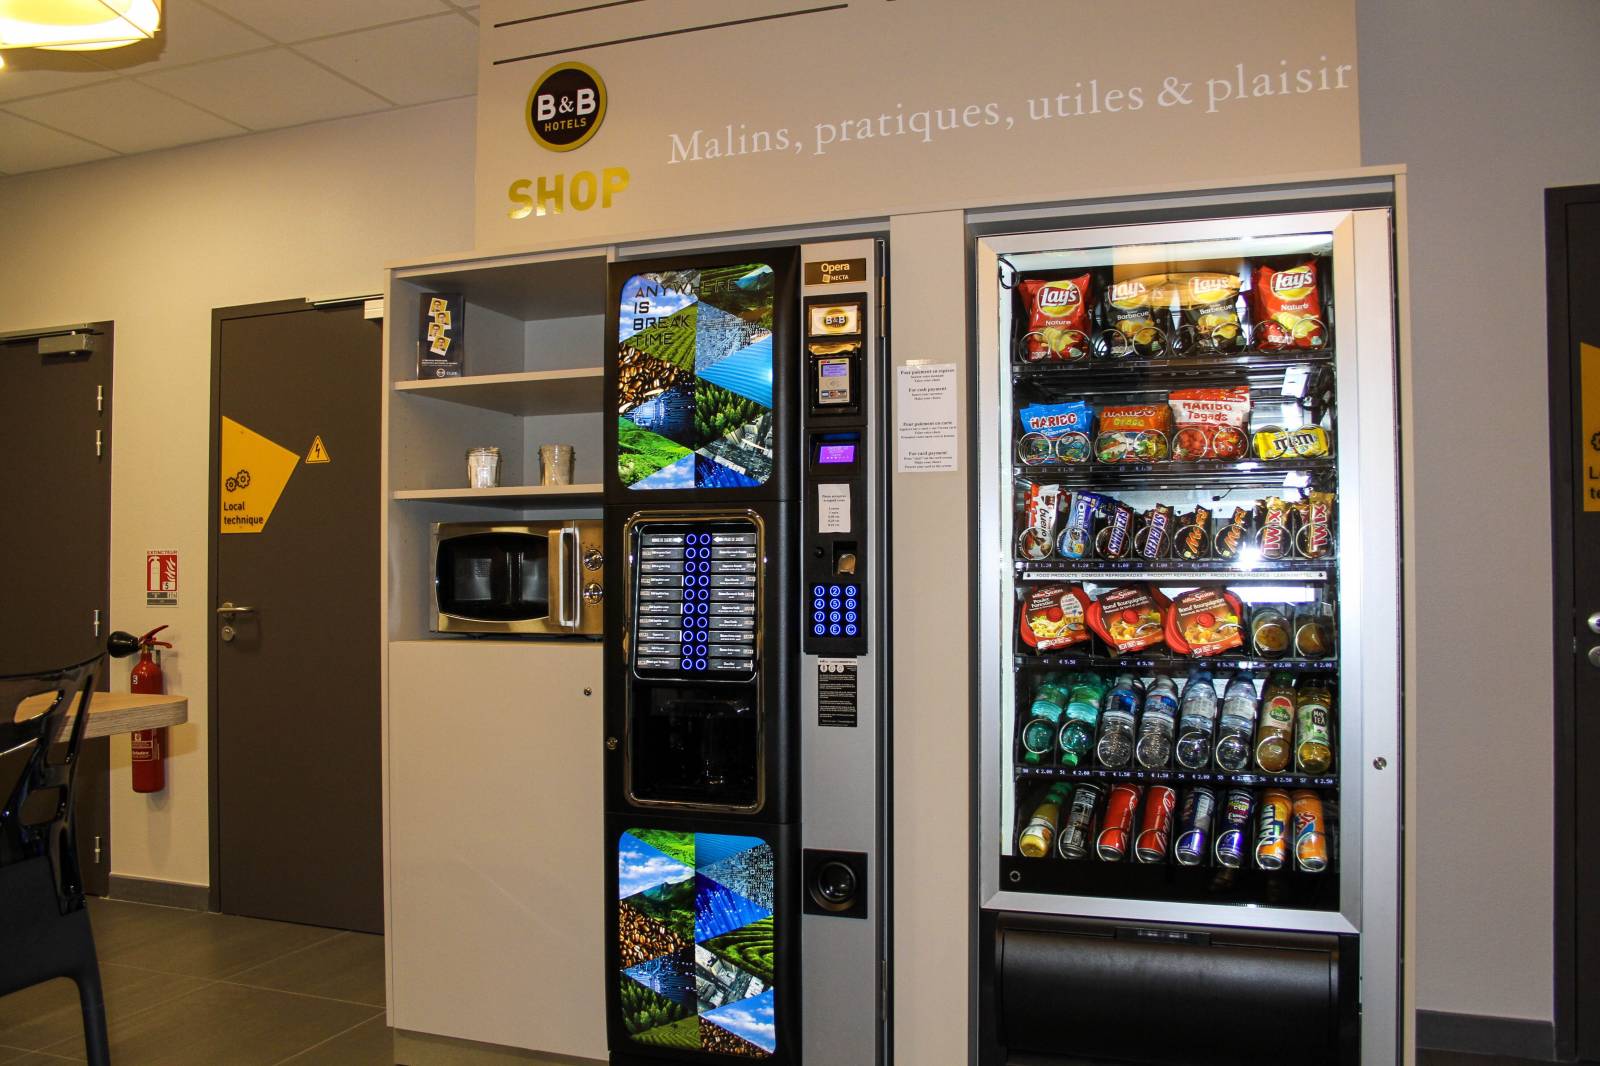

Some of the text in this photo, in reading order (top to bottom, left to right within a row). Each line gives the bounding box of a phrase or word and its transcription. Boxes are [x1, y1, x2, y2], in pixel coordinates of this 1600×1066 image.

[536, 88, 597, 121] B&B
[667, 56, 1353, 165] Malins, pratiques, utiles & plaisir
[544, 117, 588, 132] HOTELS
[507, 166, 631, 220] SHOP
[821, 263, 850, 274] Opera
[635, 279, 737, 298] ANYWHERE
[634, 301, 650, 314] IS
[633, 315, 690, 331] BREAK
[633, 332, 674, 346] TIME
[1030, 412, 1078, 429] HARIBO
[224, 500, 245, 511] Local
[224, 514, 264, 526] technique
[1039, 508, 1050, 538] bueno
[1144, 513, 1167, 559] SNICKERS
